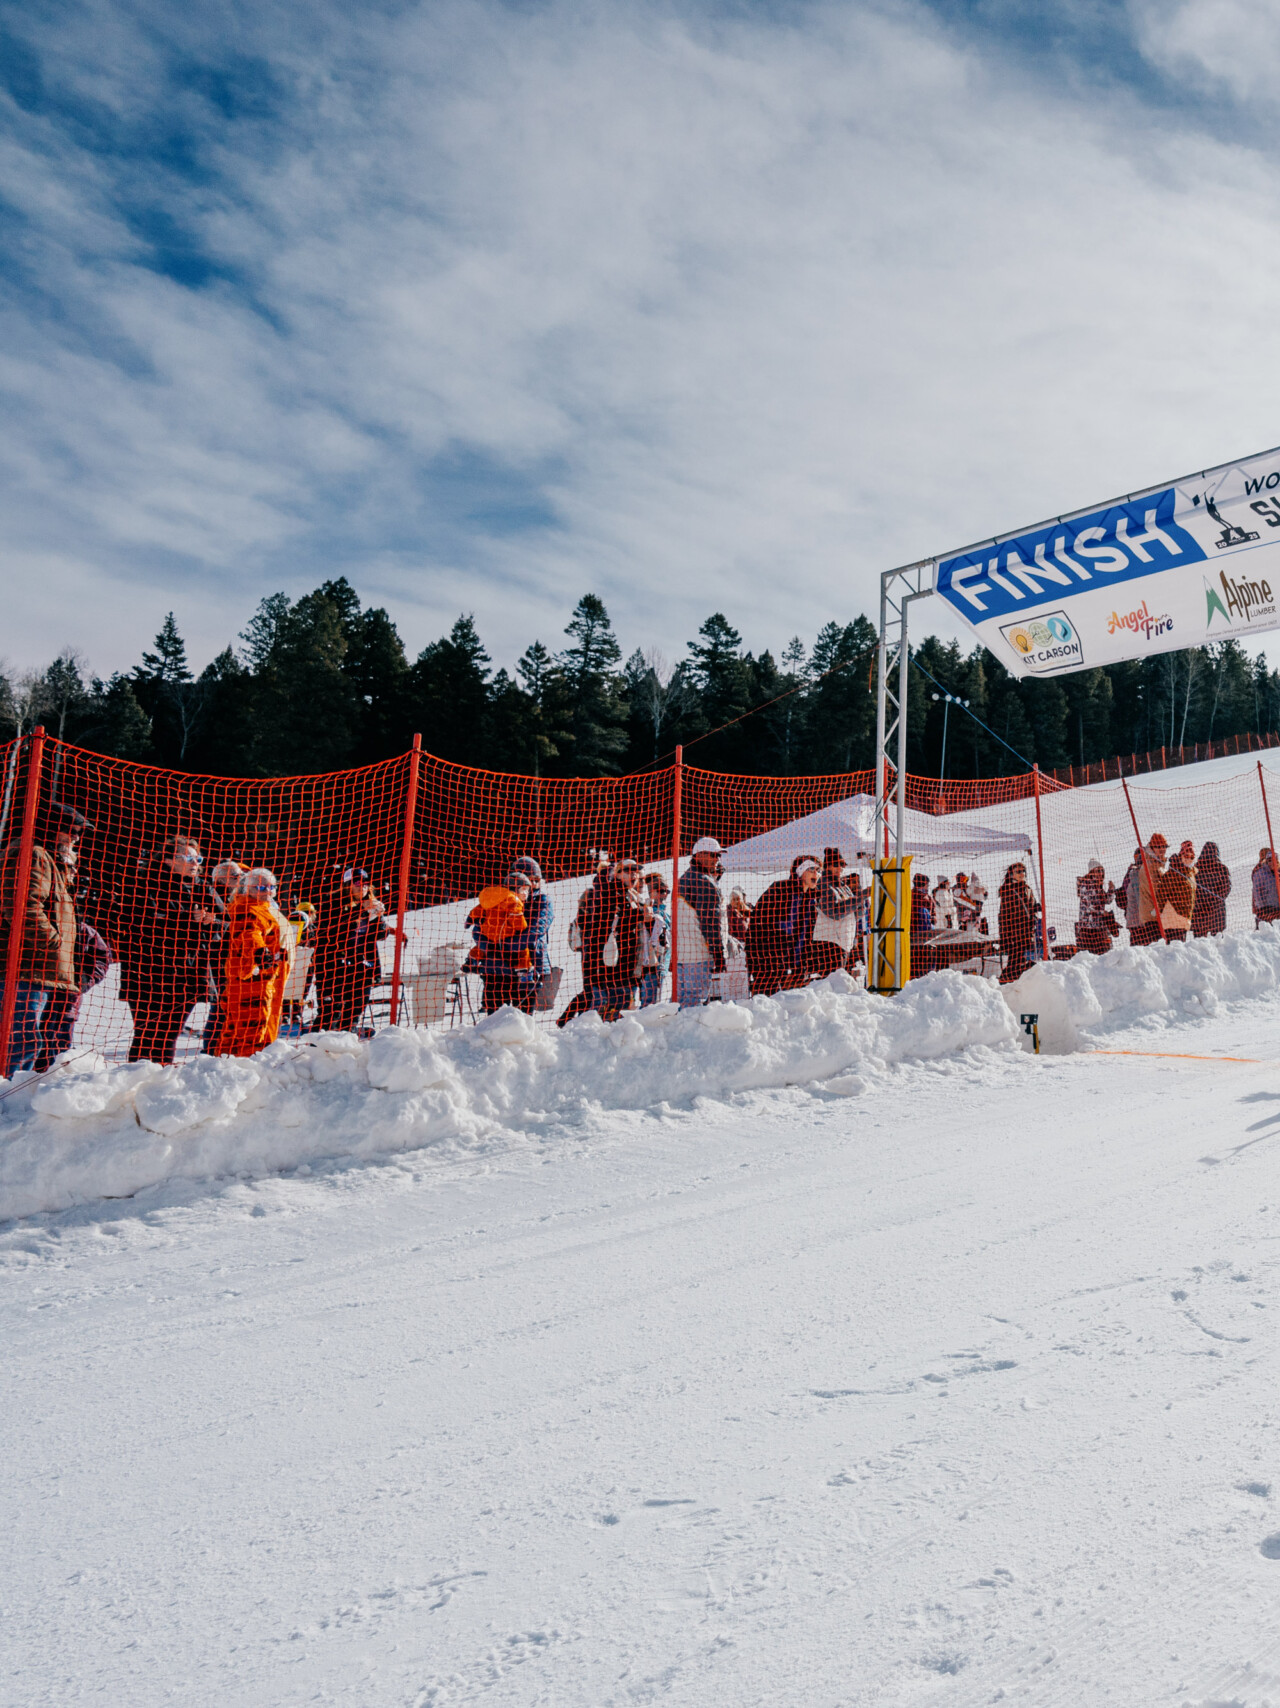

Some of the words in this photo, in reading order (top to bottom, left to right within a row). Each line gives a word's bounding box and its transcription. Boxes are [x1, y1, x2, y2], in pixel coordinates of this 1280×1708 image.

[951, 508, 1184, 612] FINISH
[1219, 569, 1274, 622] Alpine
[1107, 600, 1149, 635] Angel
[1250, 605, 1277, 618] LUMBER
[1140, 615, 1174, 641] Fire
[1038, 643, 1079, 662] CARSON
